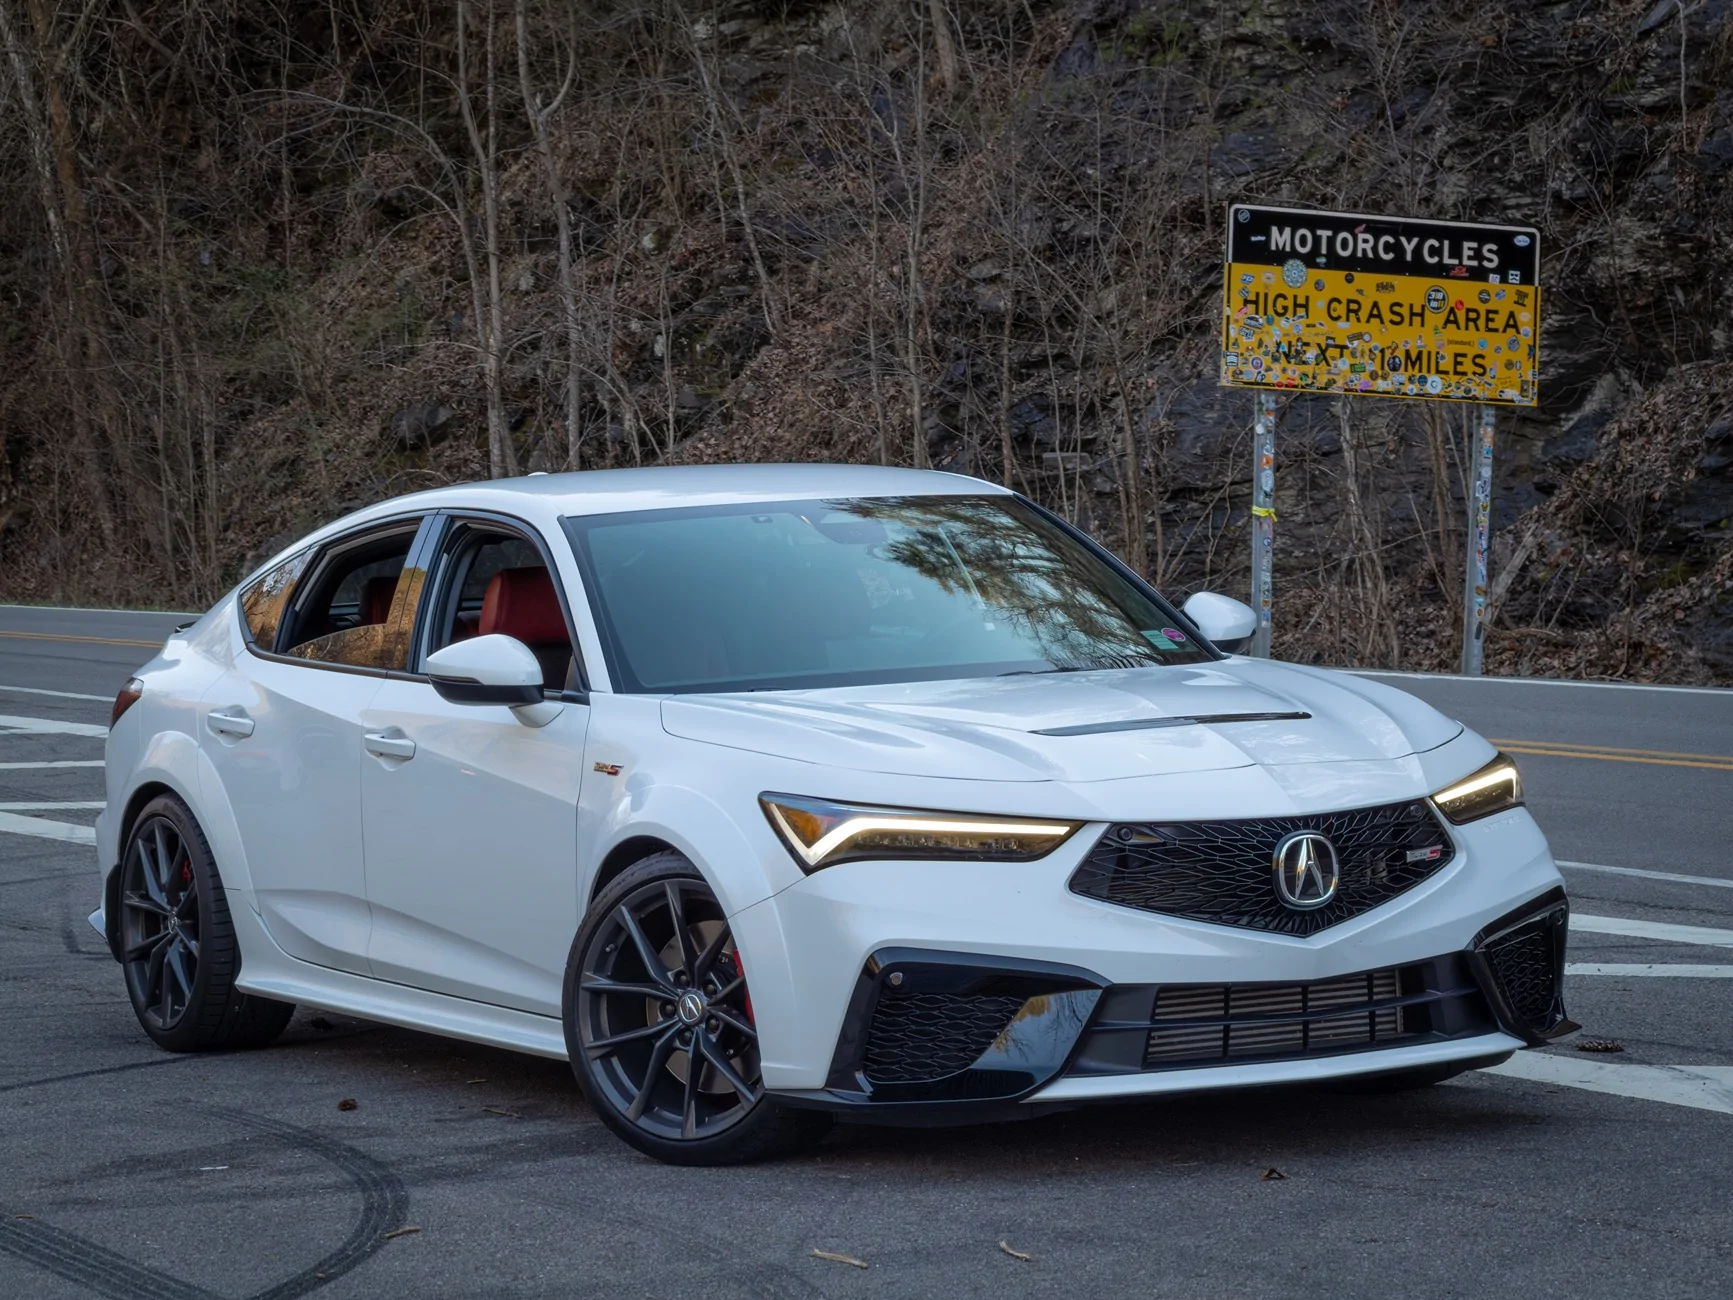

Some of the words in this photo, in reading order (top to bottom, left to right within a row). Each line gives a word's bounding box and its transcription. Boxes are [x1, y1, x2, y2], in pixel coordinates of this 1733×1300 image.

[1270, 225, 1499, 269] MOTORCYCLES
[1243, 291, 1310, 320] HIGH
[1327, 297, 1426, 329] CRASH
[1442, 306, 1521, 335] AREA
[1404, 349, 1488, 377] MILES
